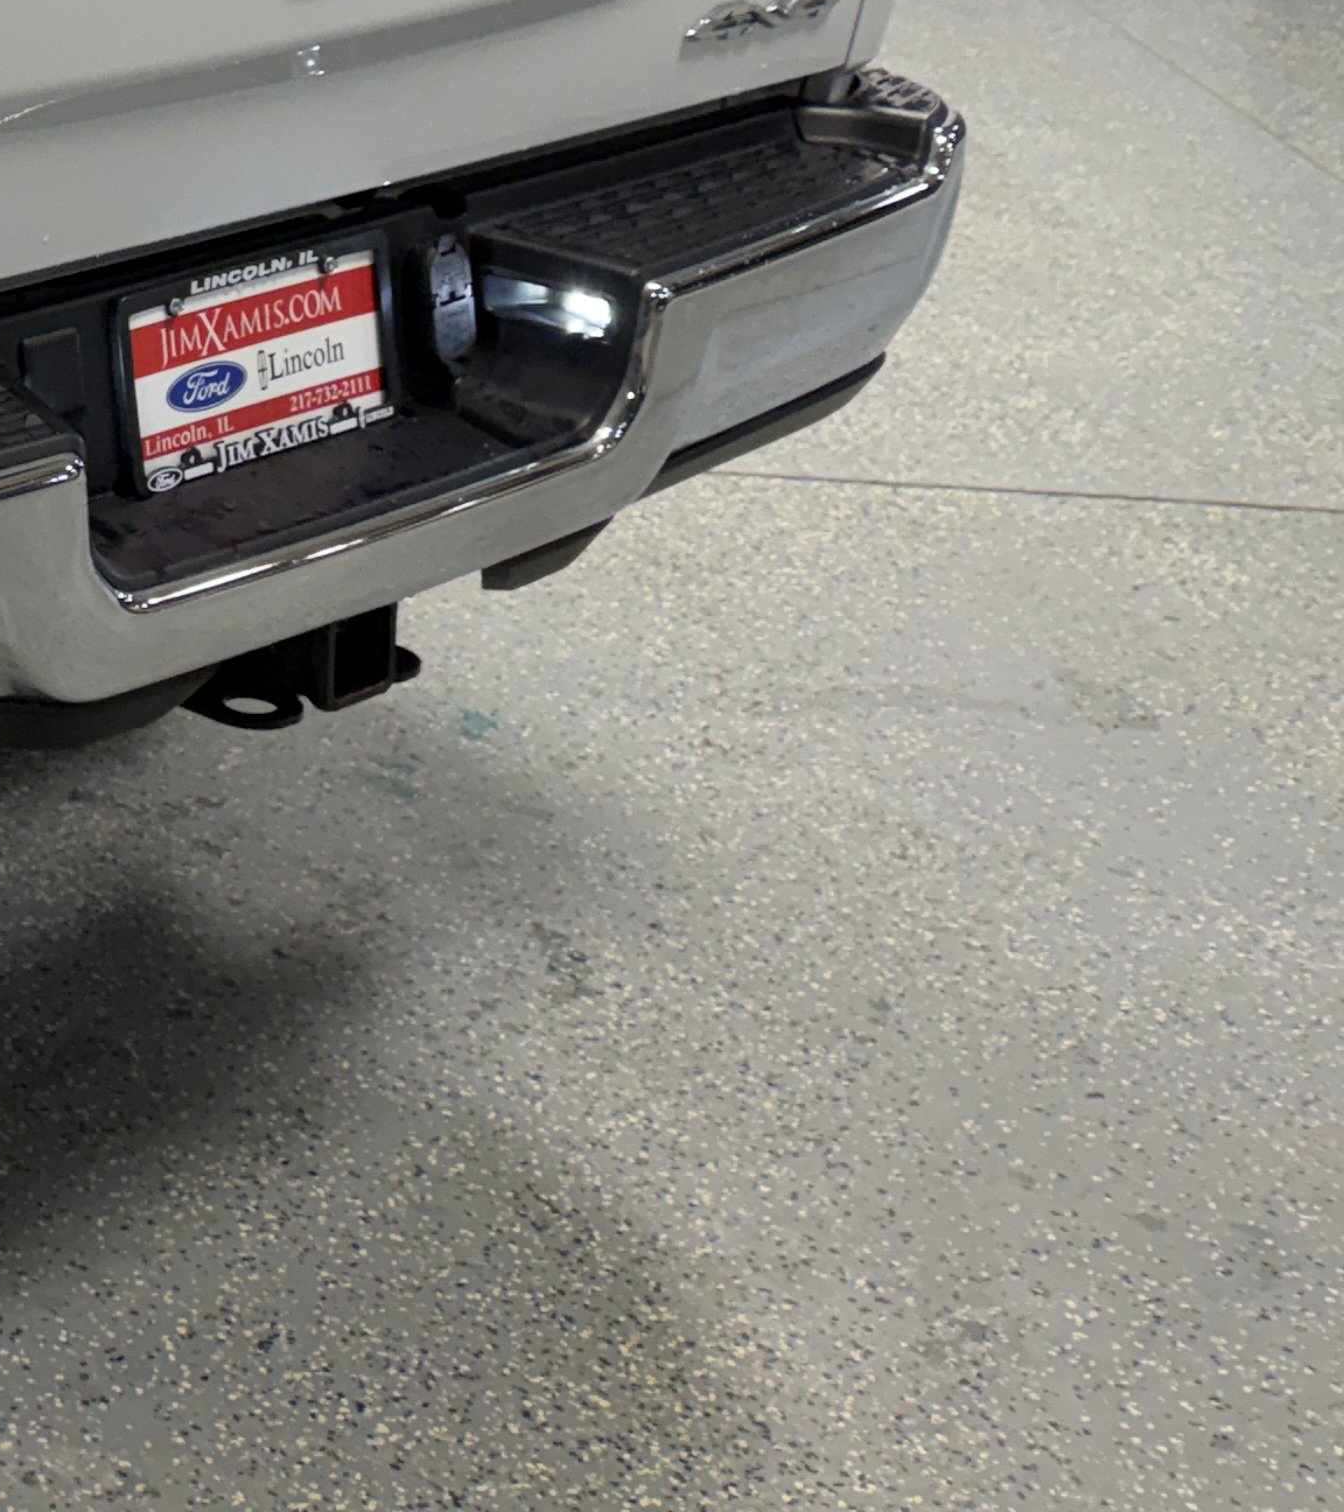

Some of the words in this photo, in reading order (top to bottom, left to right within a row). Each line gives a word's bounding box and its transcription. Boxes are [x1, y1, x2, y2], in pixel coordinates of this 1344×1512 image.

[190, 256, 292, 294] LINCOLN,
[298, 250, 319, 265] IL
[160, 286, 343, 367] JIMXAMIS.COM
[268, 337, 345, 382] Lincoln
[183, 368, 232, 405] Ford
[289, 375, 372, 413] 217-732-2111
[144, 424, 213, 457] Lincoln,
[217, 415, 234, 434] IL
[216, 441, 258, 472] JIM
[261, 419, 330, 456] XAMIS
